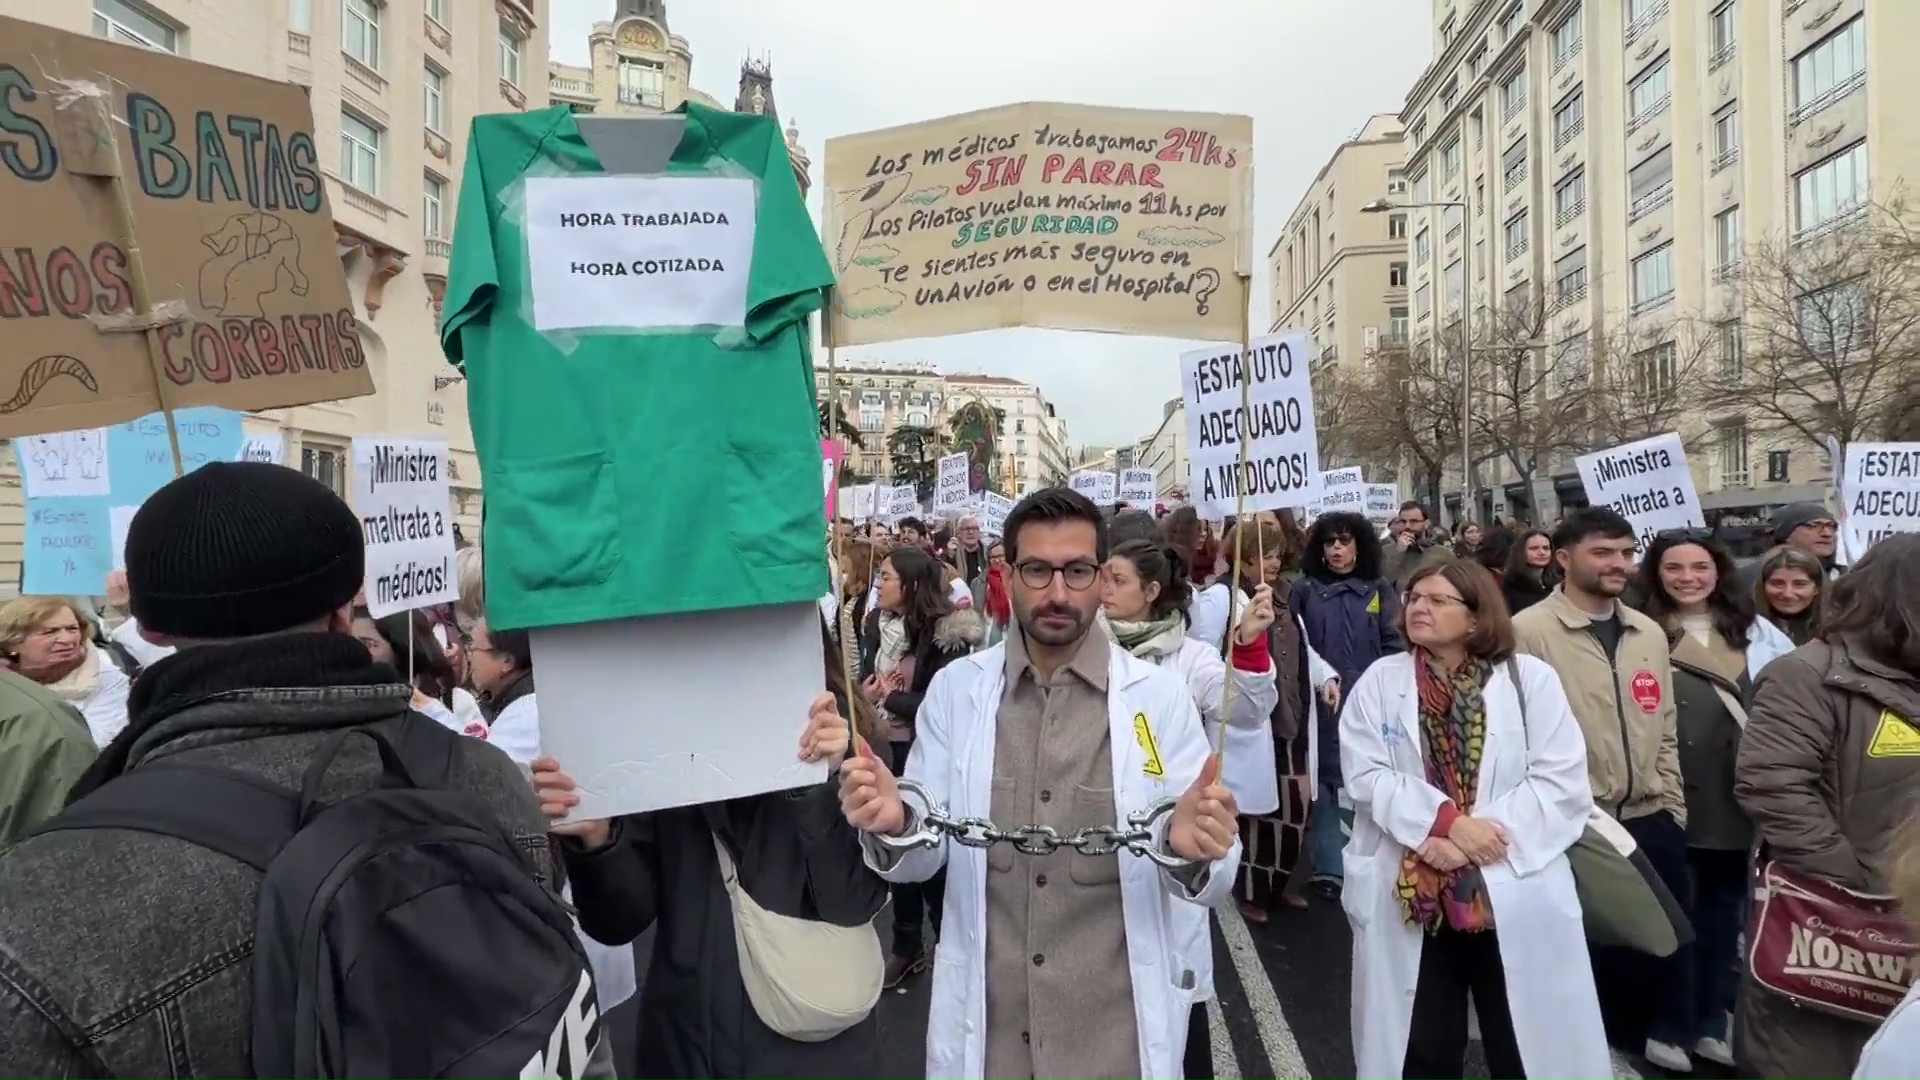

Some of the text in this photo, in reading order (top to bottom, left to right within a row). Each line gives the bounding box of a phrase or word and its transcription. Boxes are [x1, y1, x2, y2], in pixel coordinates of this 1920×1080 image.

[126, 92, 323, 214] BATAS
[922, 132, 1020, 166] médicos
[1034, 123, 1159, 154] trabajamos
[1156, 127, 1237, 169] 24hs
[956, 153, 1164, 196] SIN PARAR
[561, 211, 730, 228] HORA TRABAJADA
[908, 205, 973, 232] Pilotos
[1056, 194, 1133, 214] máximo
[1194, 203, 1228, 222] por
[951, 213, 1119, 249] SEGURIDAD
[571, 258, 725, 276] HORA COTIZADA
[879, 263, 909, 283] Te
[921, 251, 999, 278] sientes
[1003, 241, 1060, 263] más
[1160, 250, 1191, 267] en
[1024, 275, 1036, 291] o
[160, 308, 365, 386] CORBATAS
[370, 445, 437, 494] ¡Ministra
[1204, 467, 1217, 502] A
[1593, 448, 1672, 491] ¡Ministra
[1607, 486, 1686, 518] altrata a
[1853, 491, 1920, 517] ADECU
[364, 504, 444, 546] maltrata a
[377, 556, 448, 606] médicos!
